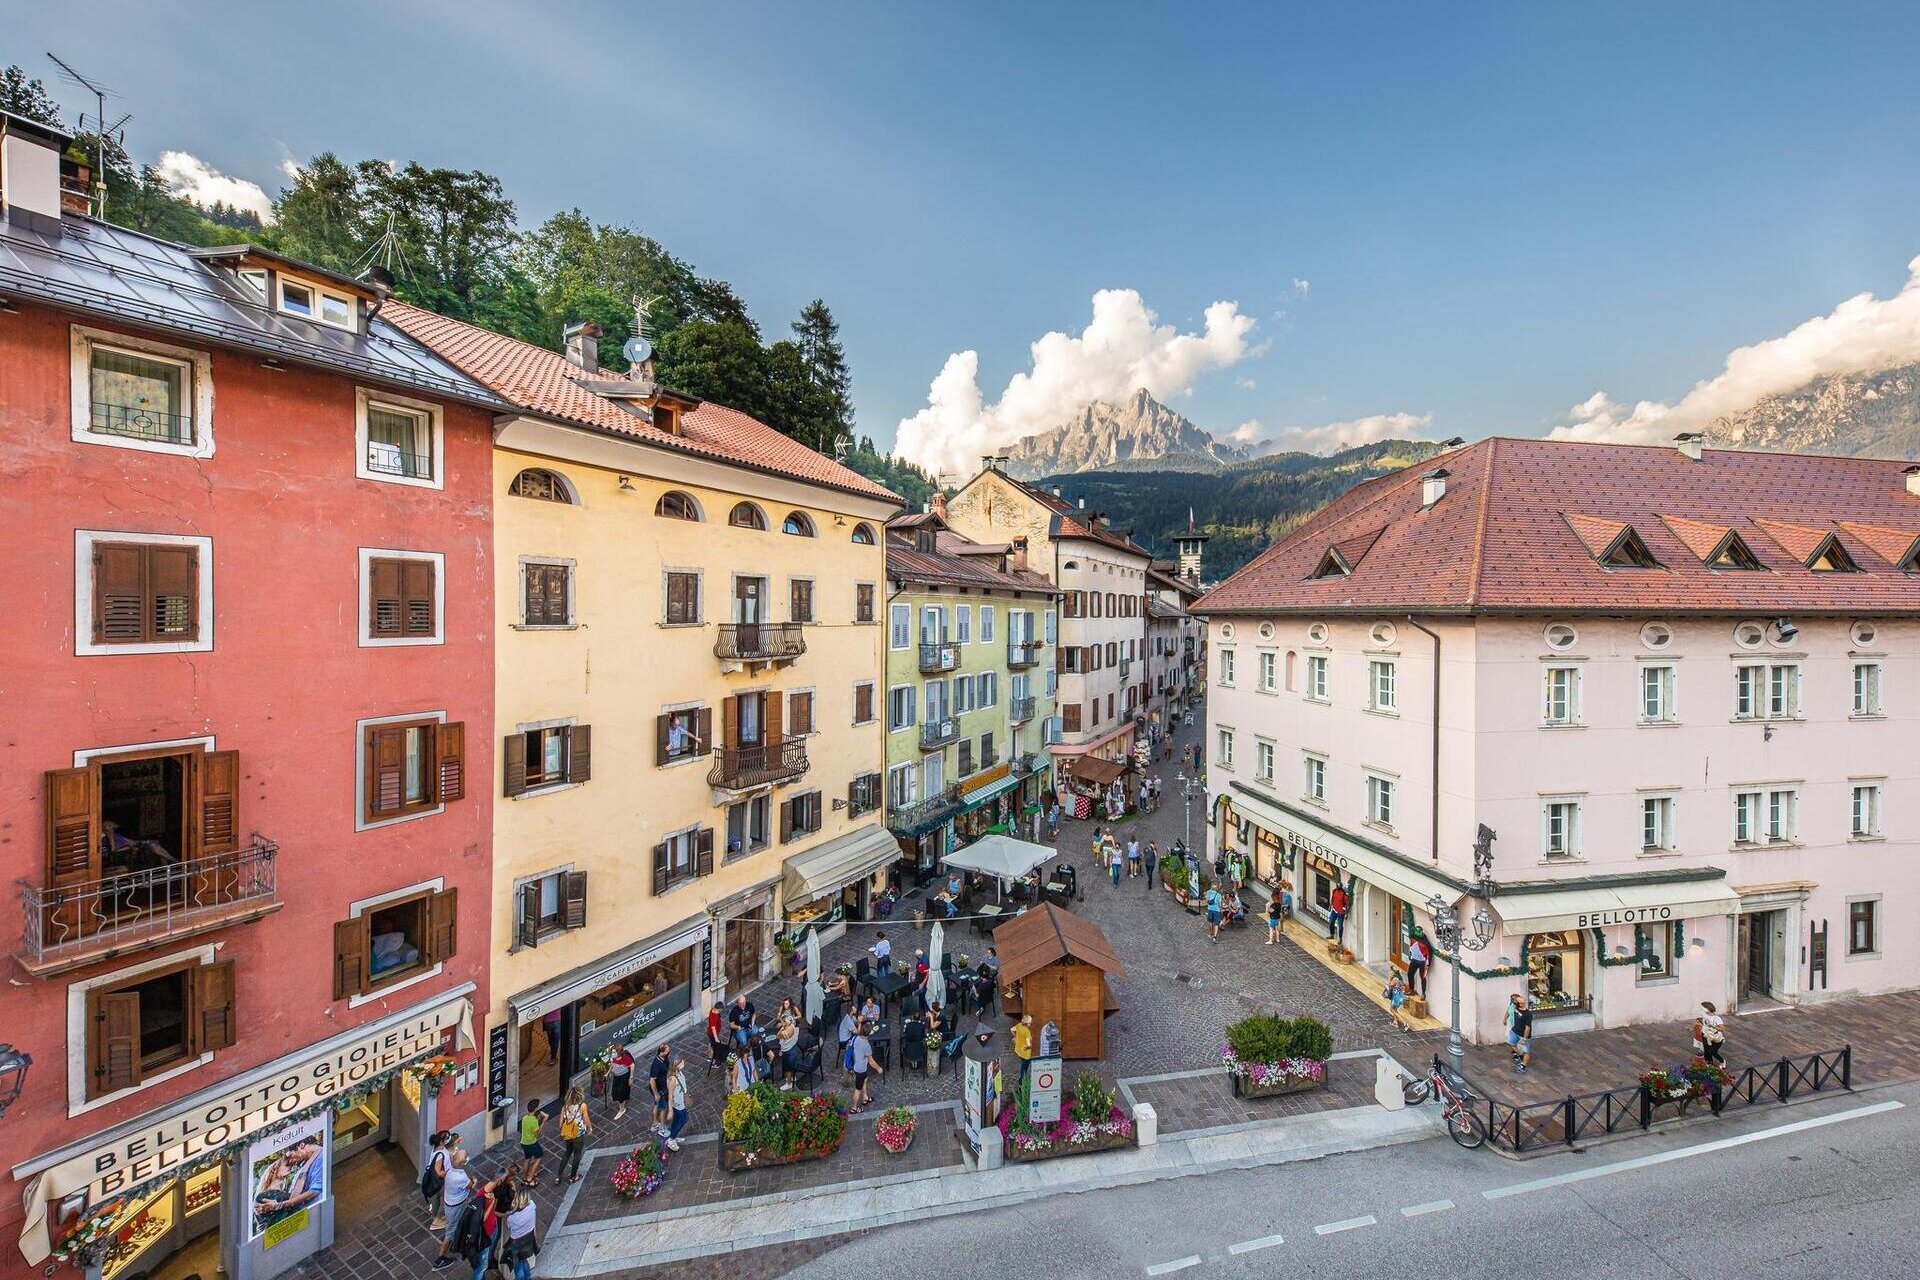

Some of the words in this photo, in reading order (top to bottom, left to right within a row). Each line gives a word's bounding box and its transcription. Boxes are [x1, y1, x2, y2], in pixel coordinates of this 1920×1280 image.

[1289, 831, 1348, 869] BELLOTTO
[1578, 907, 1671, 927] BELLOTTO
[606, 953, 657, 981] CAFFETTERIA
[612, 1007, 662, 1039] CAFFETTERIA
[96, 1075, 300, 1173] BELLOTTO
[312, 1014, 440, 1077] GIOIELLI
[101, 1093, 301, 1195] BELLOTTO
[314, 1032, 435, 1096] GIOIELLI
[272, 1125, 305, 1147] Kidult
